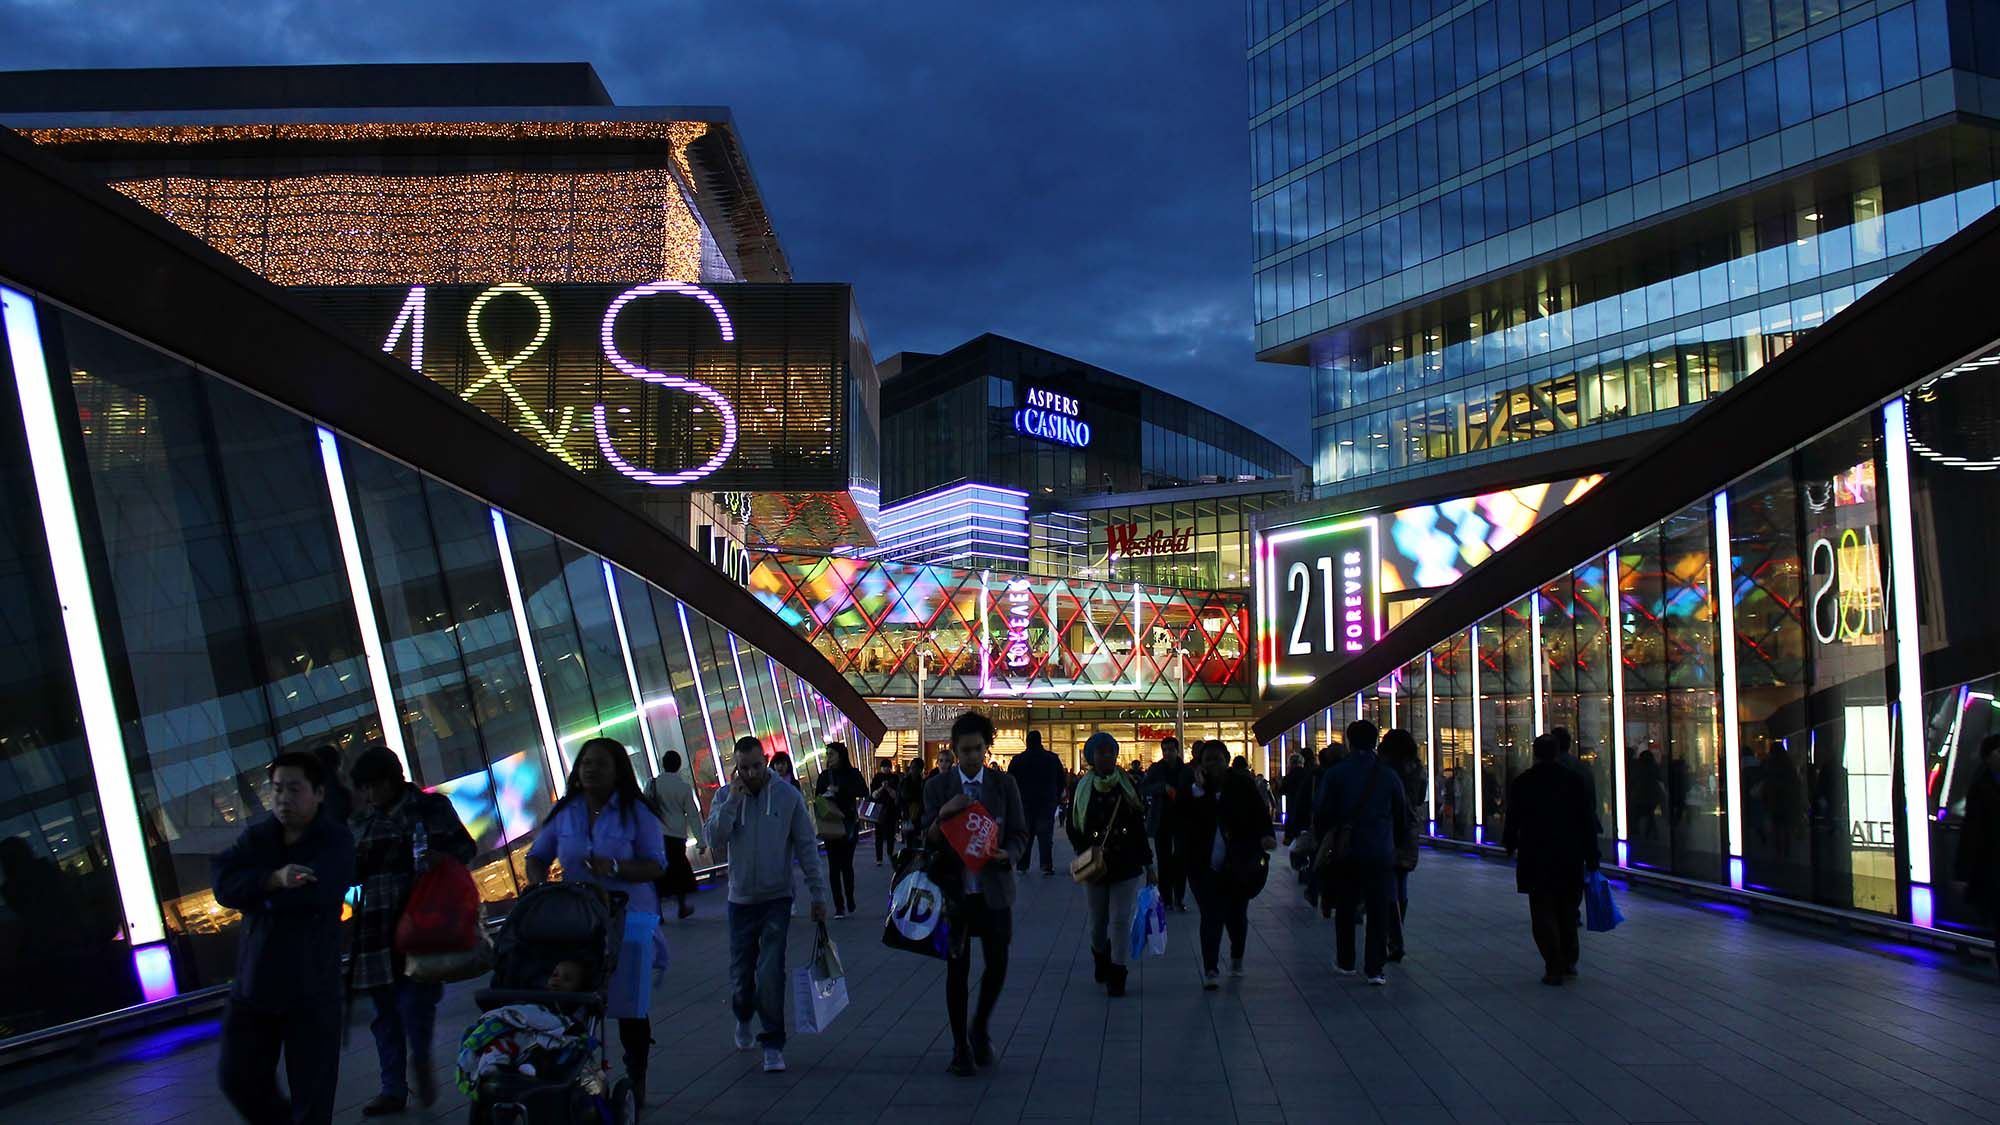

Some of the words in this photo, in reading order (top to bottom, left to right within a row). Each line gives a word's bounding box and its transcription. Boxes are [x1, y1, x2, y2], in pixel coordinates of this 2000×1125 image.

[1027, 387, 1079, 416] ASPERS
[1024, 408, 1090, 447] CASINO
[1104, 522, 1194, 556] Westfield
[1287, 556, 1335, 655] 21
[1343, 551, 1363, 651] FOREVER
[896, 887, 935, 923] JD
